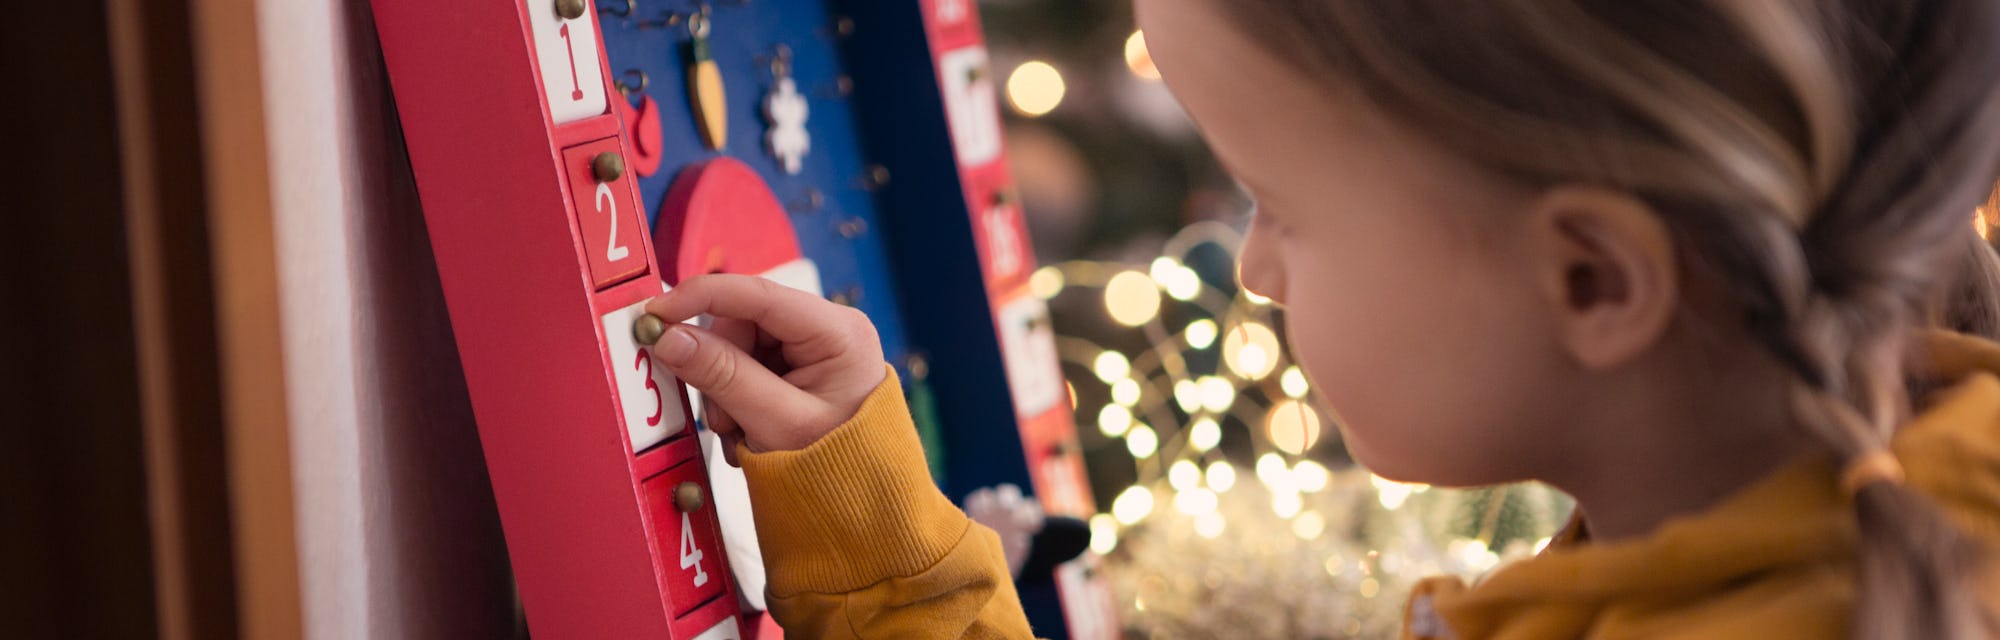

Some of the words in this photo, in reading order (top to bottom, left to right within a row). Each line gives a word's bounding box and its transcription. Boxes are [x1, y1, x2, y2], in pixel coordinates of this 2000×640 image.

[560, 23, 583, 100] 1
[596, 183, 629, 261] 2
[635, 348, 662, 426] 3
[680, 511, 708, 587] 4
